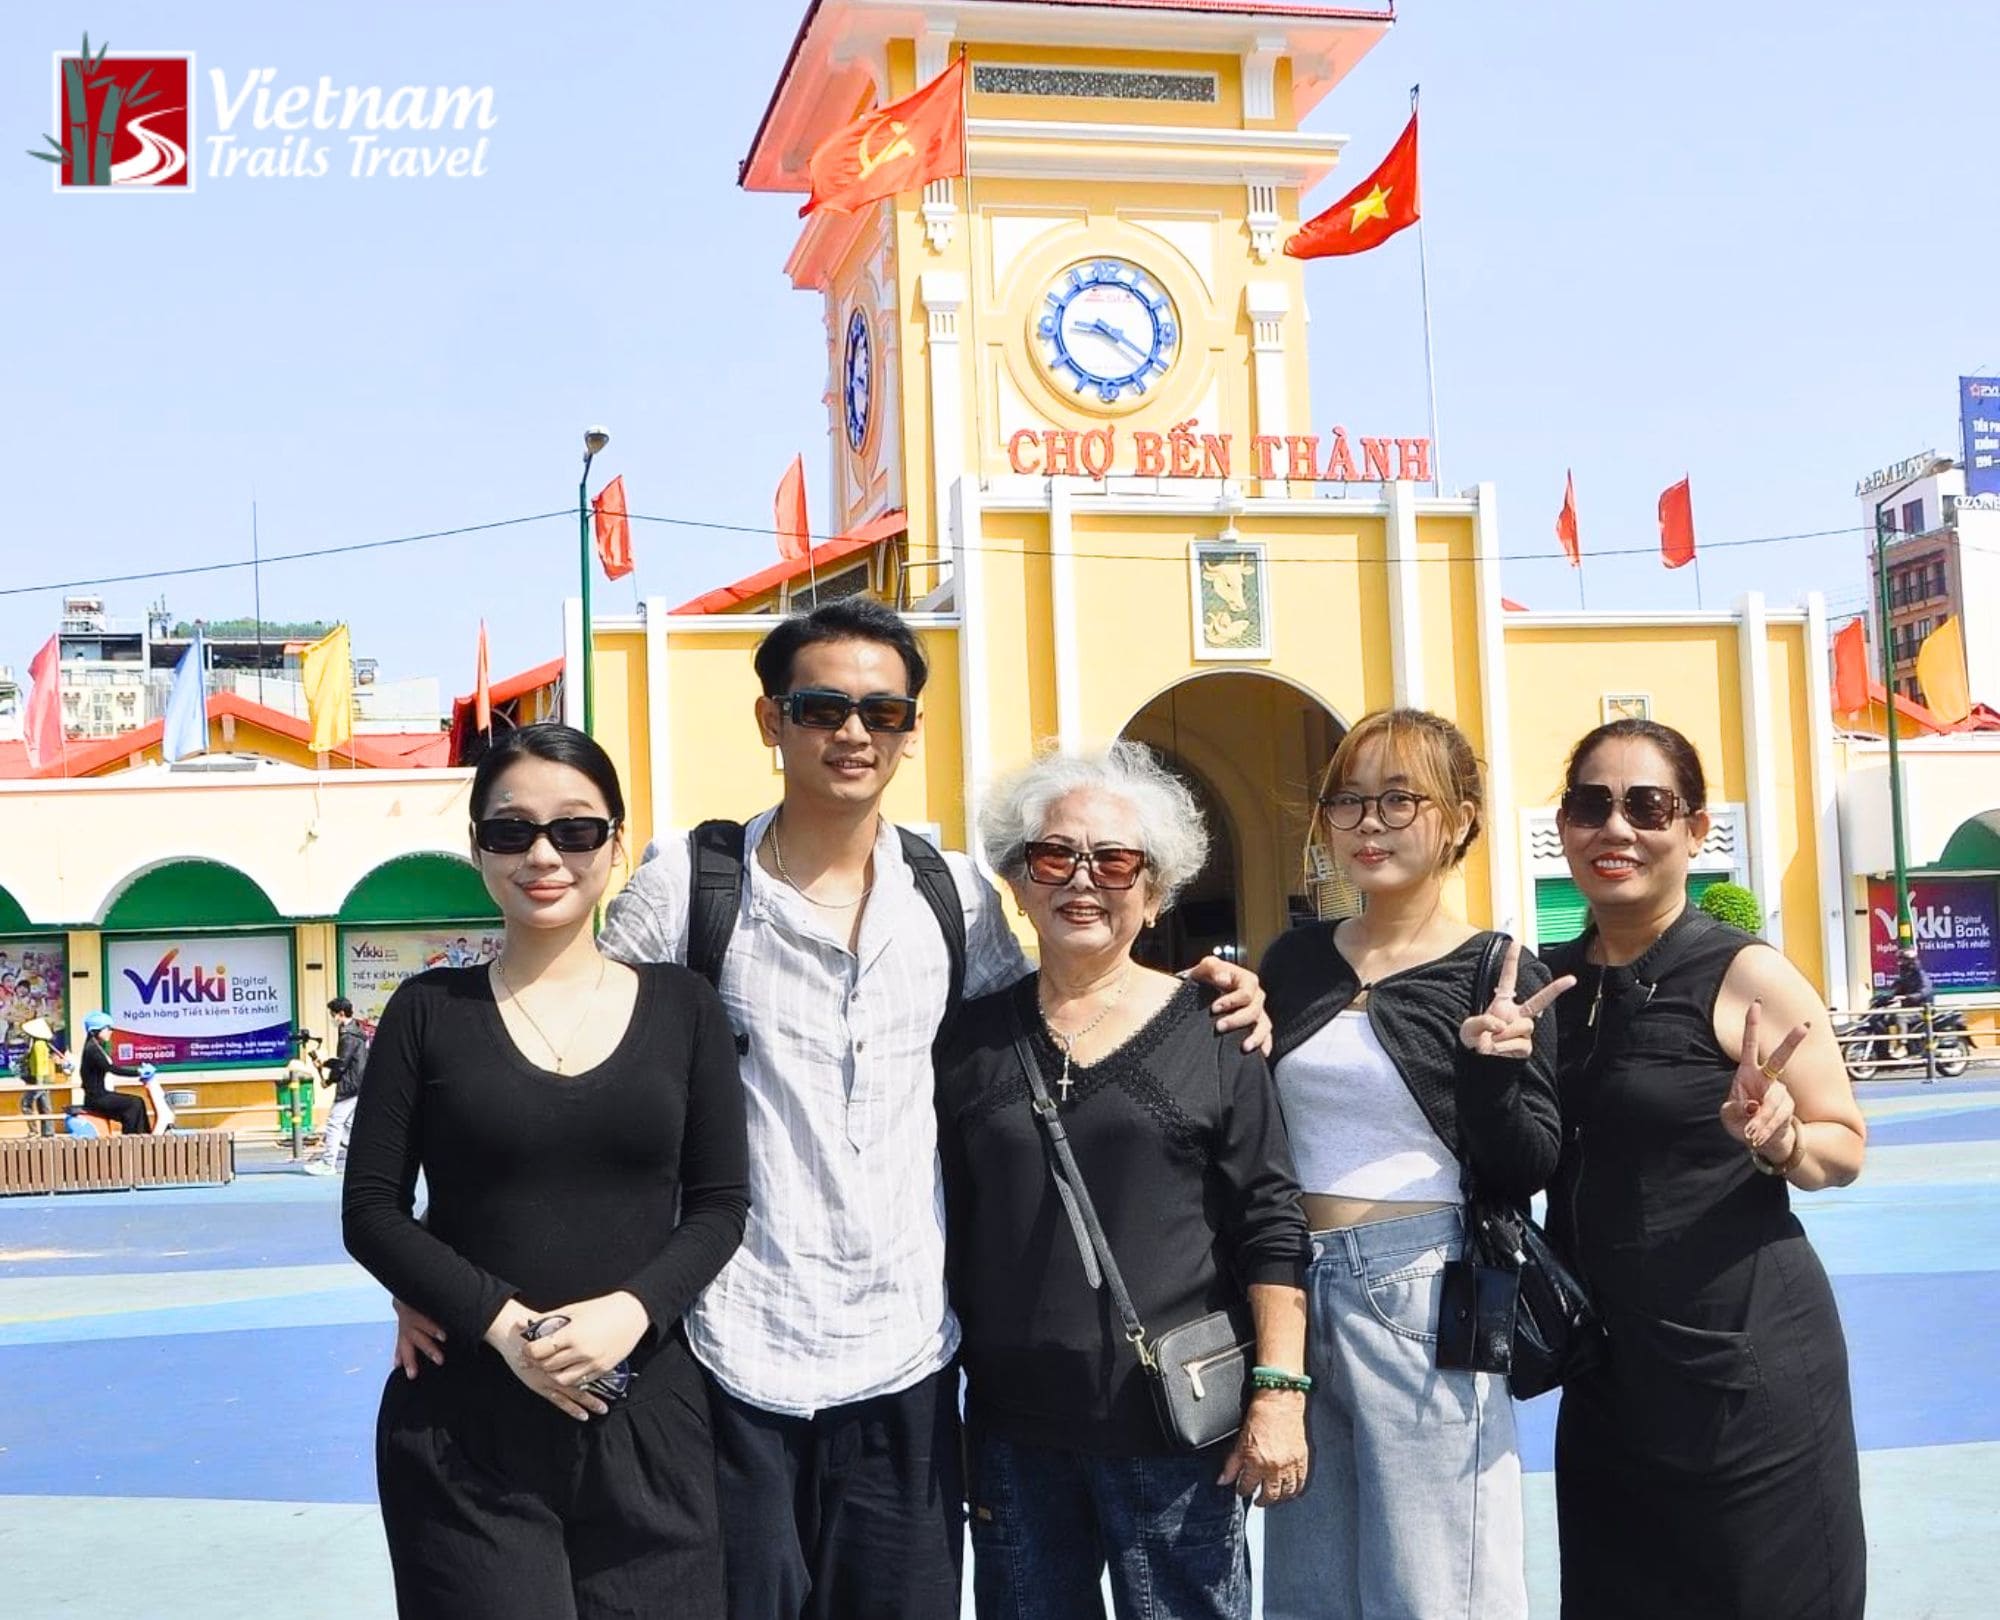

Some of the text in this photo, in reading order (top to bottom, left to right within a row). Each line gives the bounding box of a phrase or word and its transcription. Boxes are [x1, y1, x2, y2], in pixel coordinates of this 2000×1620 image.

[1008, 418, 1434, 482] CHỢ BẾN THÀNH
[1955, 923, 1990, 938] Bank
[352, 941, 383, 958] Vikki
[123, 948, 226, 1005] Vikki
[231, 976, 267, 988] Digital
[232, 986, 278, 1002] Bank
[183, 1006, 203, 1017] Tiết
